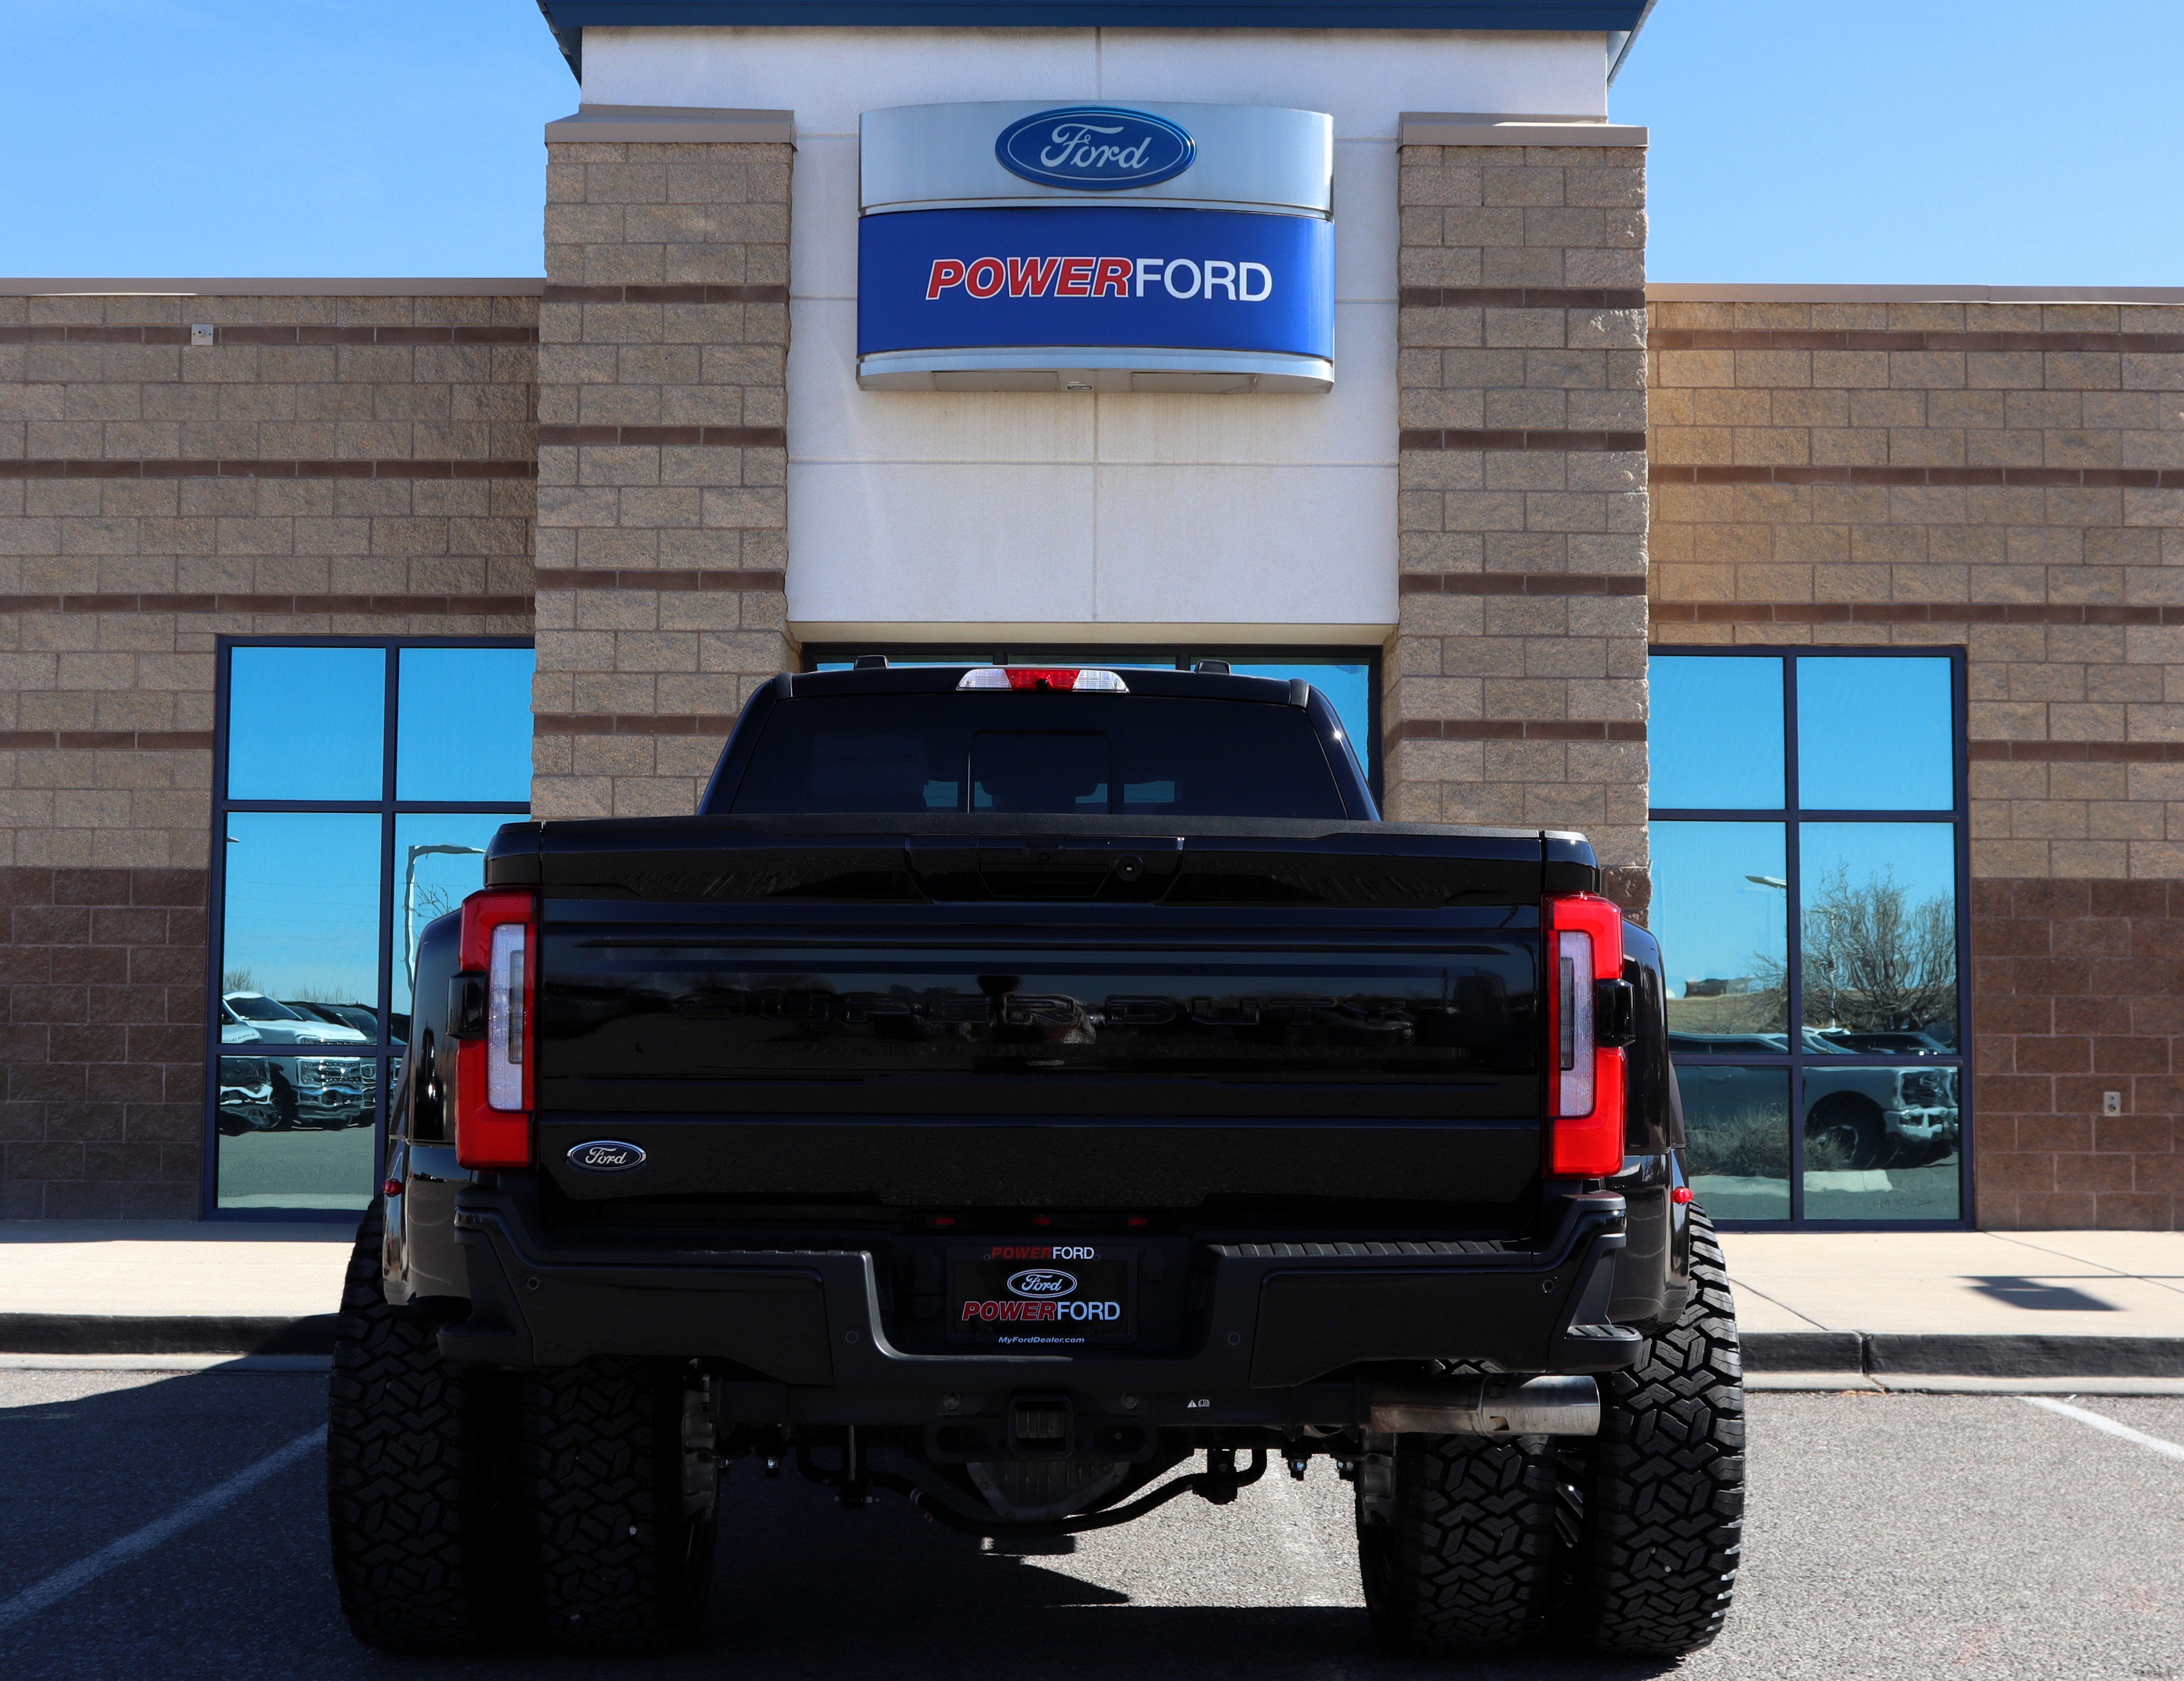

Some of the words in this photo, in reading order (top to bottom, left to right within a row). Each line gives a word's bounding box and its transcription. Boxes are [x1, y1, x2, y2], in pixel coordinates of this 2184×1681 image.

[1041, 123, 1152, 169] Ford
[926, 256, 1273, 302] POWERFORD
[585, 1147, 627, 1164] Ford
[991, 1246, 1095, 1260] POWERFORD
[1021, 1274, 1063, 1292] Ford
[962, 1301, 1121, 1321] POWERFORD
